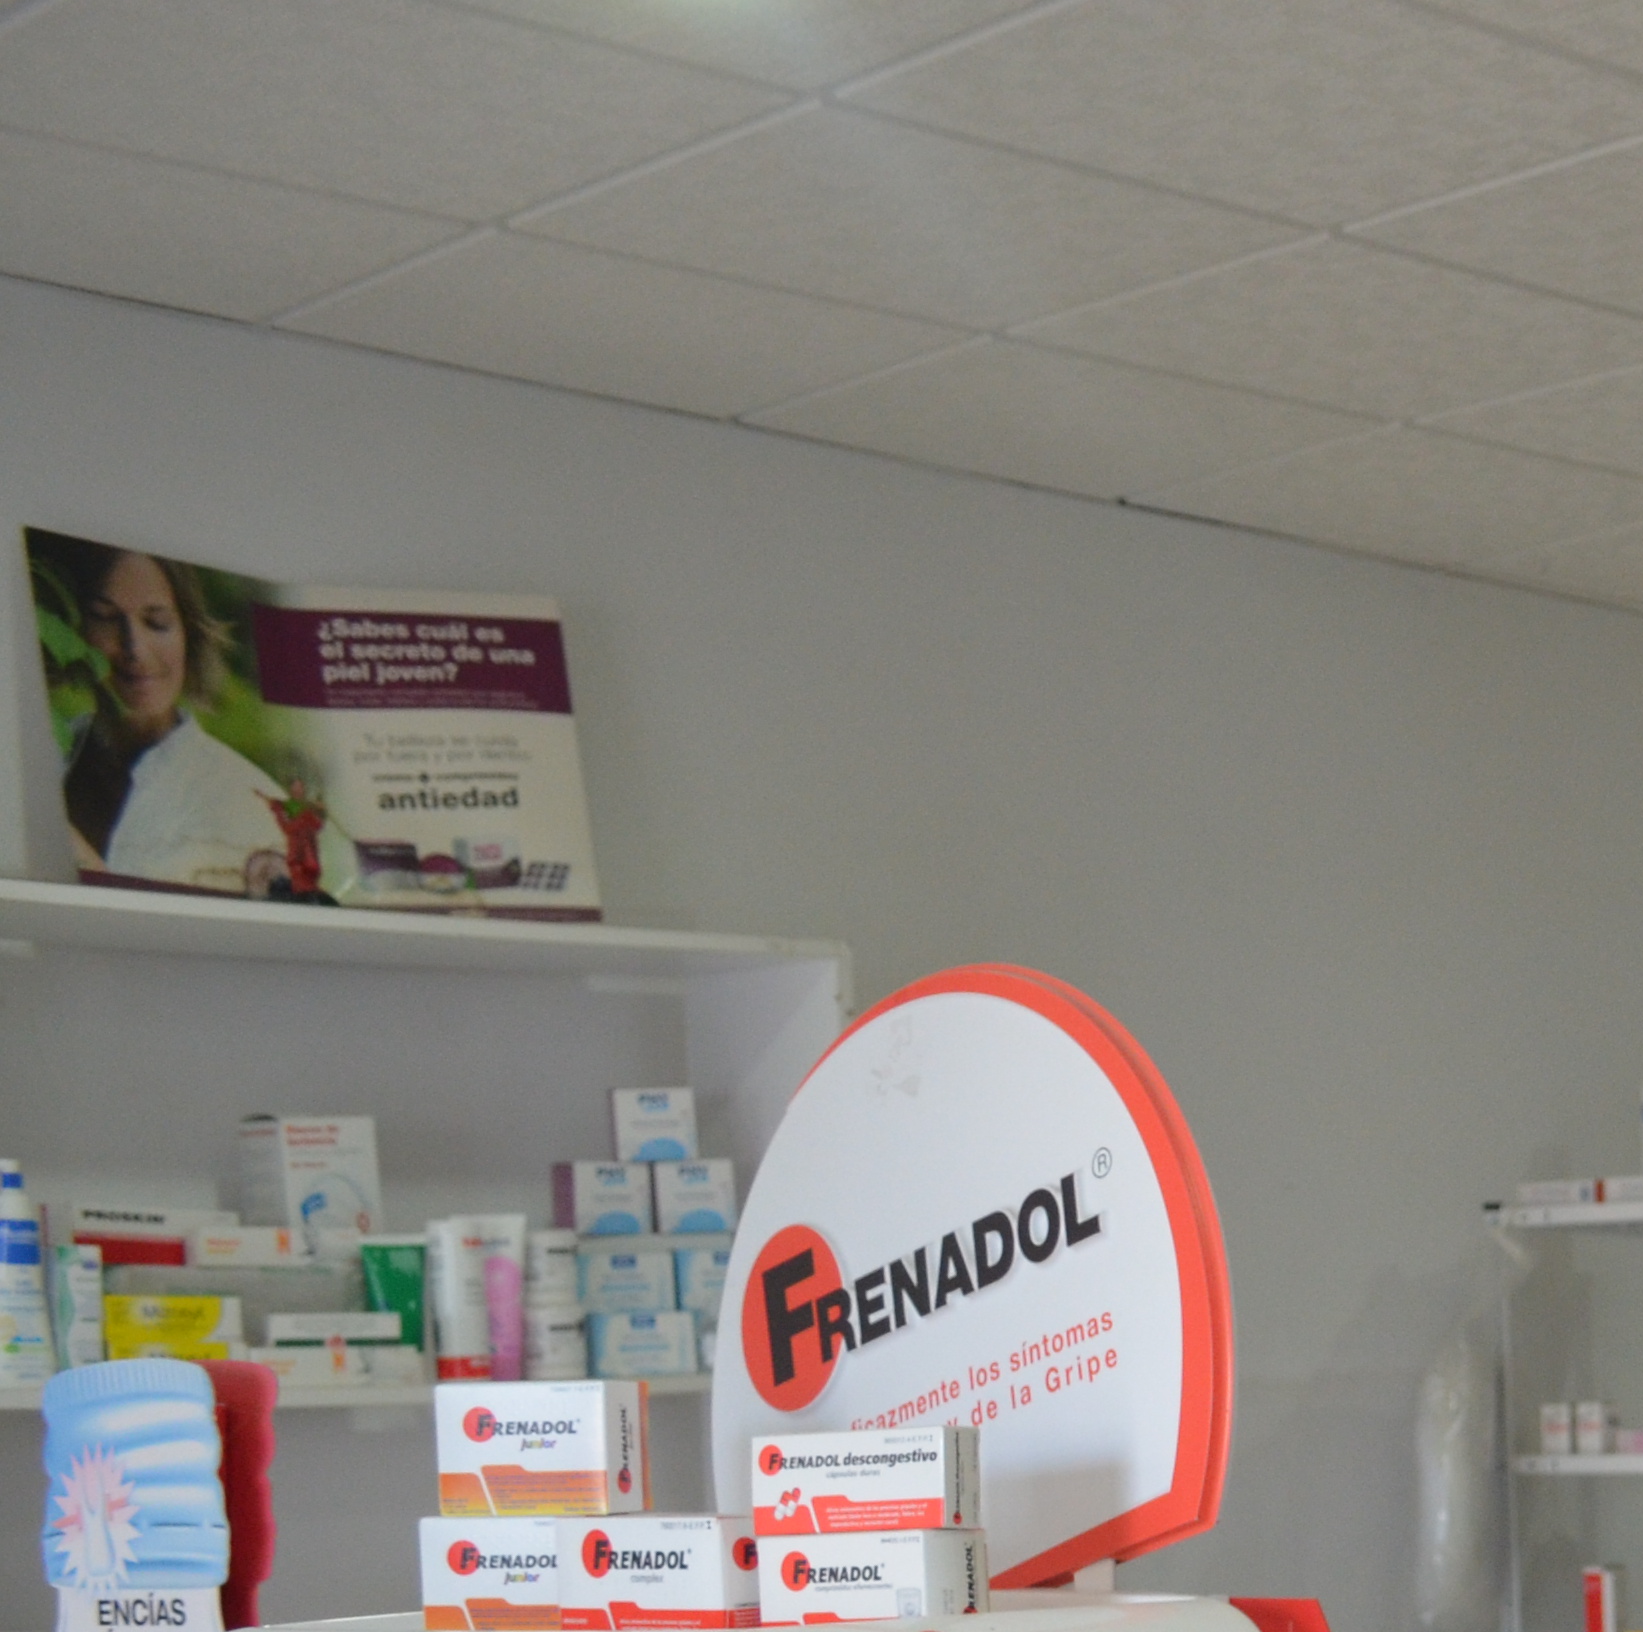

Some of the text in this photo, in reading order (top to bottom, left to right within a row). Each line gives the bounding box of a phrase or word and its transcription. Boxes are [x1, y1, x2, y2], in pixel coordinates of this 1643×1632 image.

[378, 786, 520, 811] antiedad
[761, 1172, 1102, 1387] FRENADOL
[968, 1311, 1113, 1390] los síntomas
[971, 1348, 1118, 1427] de la Gripe
[476, 1414, 577, 1436] FRENADOL
[769, 1451, 938, 1471] FRENADOL descongestivo
[593, 1540, 688, 1570] FRENADOL
[793, 1560, 882, 1584] FRENADOL
[98, 1593, 186, 1626] ENCÍAS
